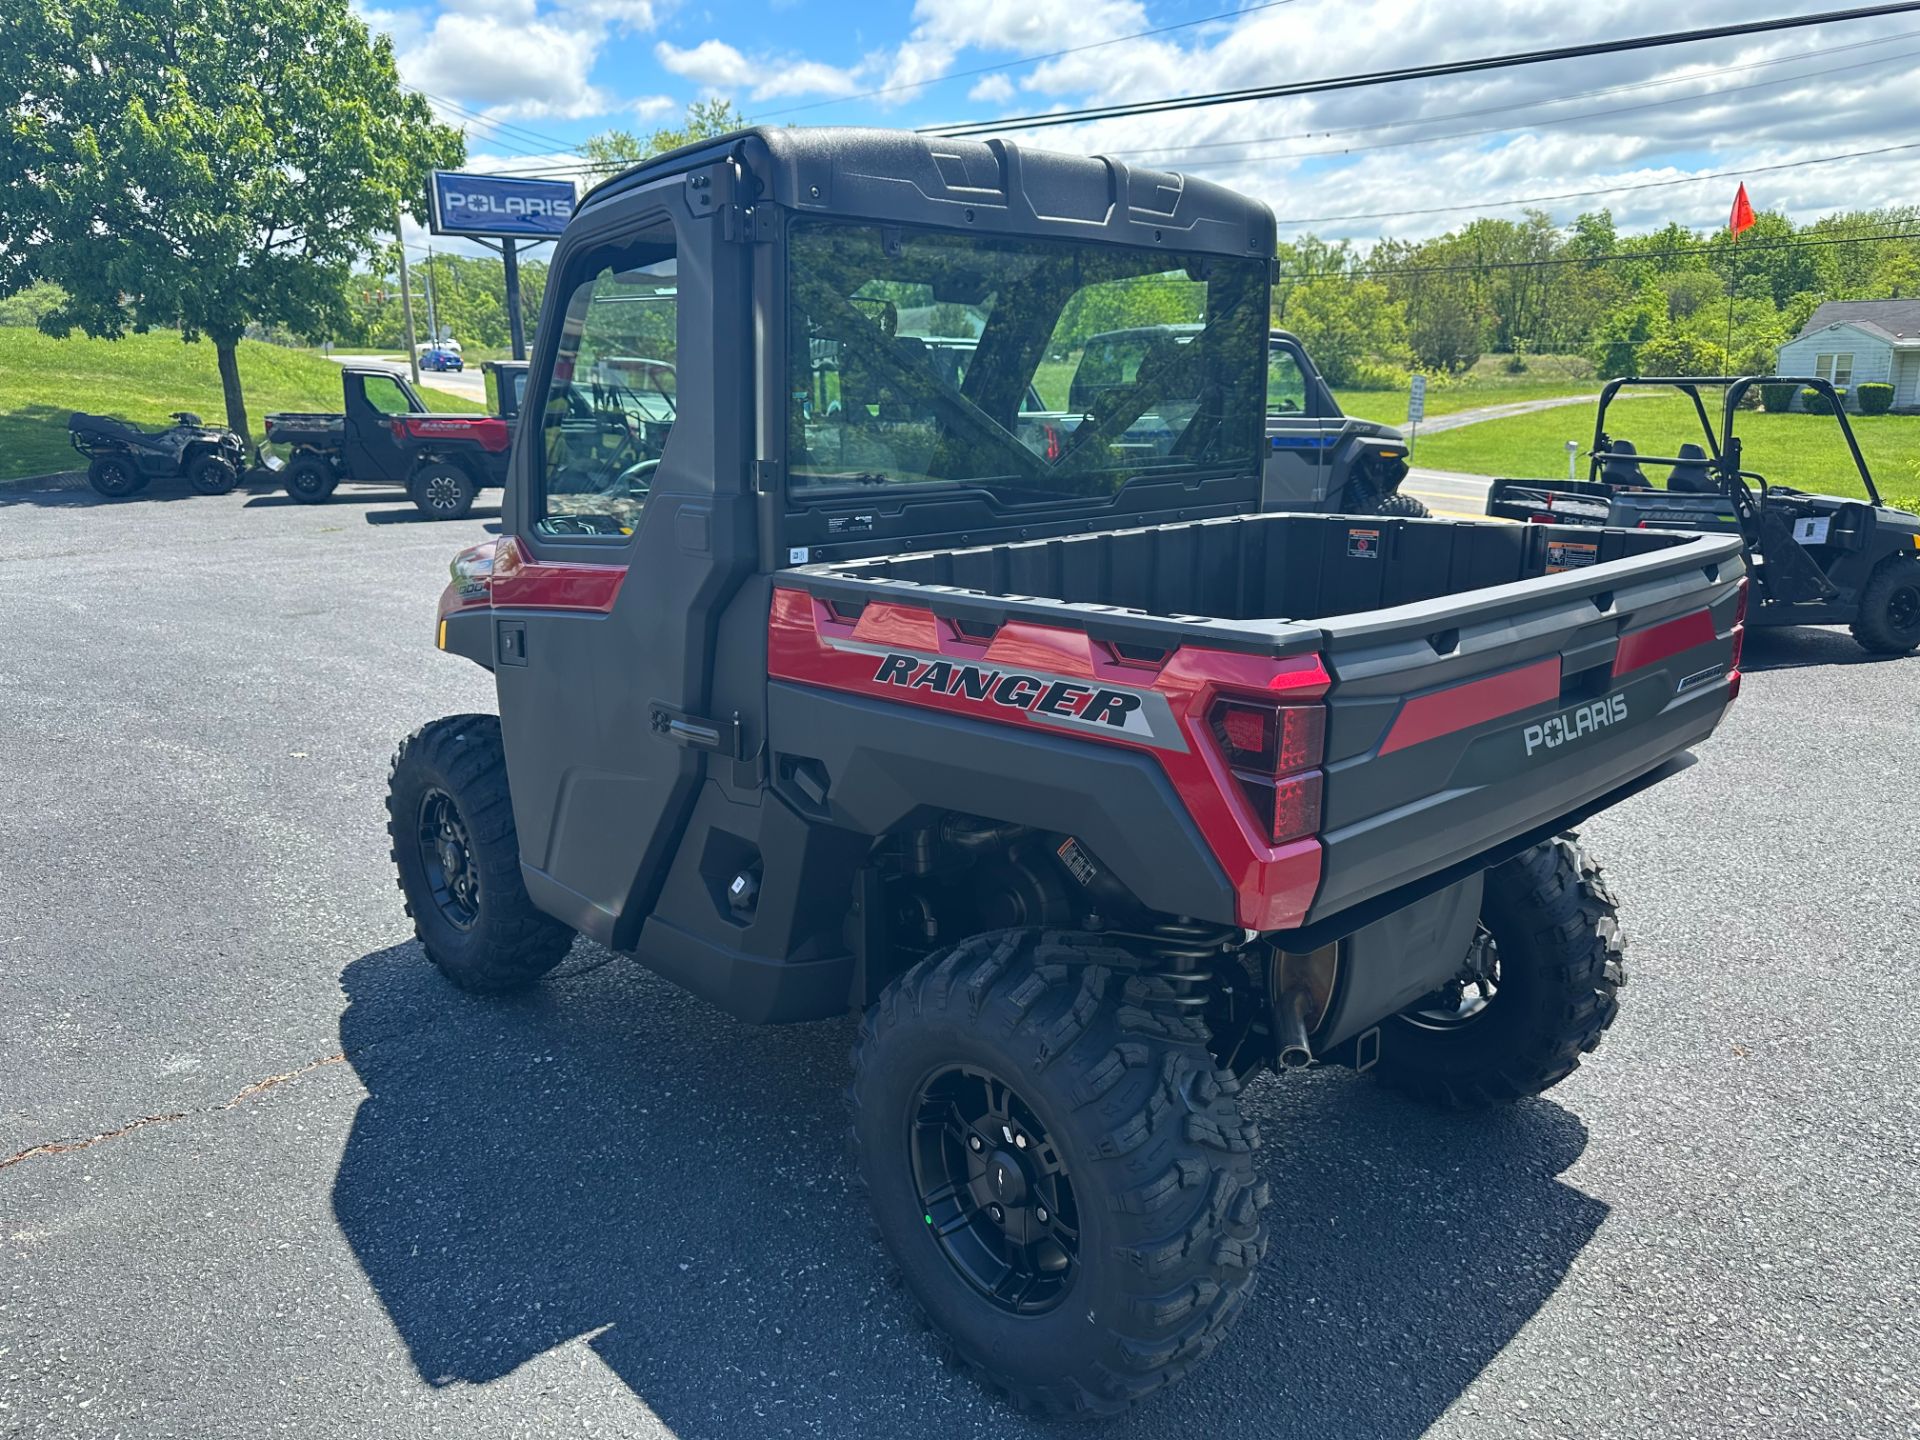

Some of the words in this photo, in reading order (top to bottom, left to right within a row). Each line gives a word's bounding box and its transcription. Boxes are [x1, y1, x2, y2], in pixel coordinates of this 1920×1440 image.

[444, 192, 572, 217] POLARIS
[1639, 511, 1705, 521] RANGER
[872, 652, 1143, 728] RANGER
[1523, 692, 1629, 757] POLARIS
